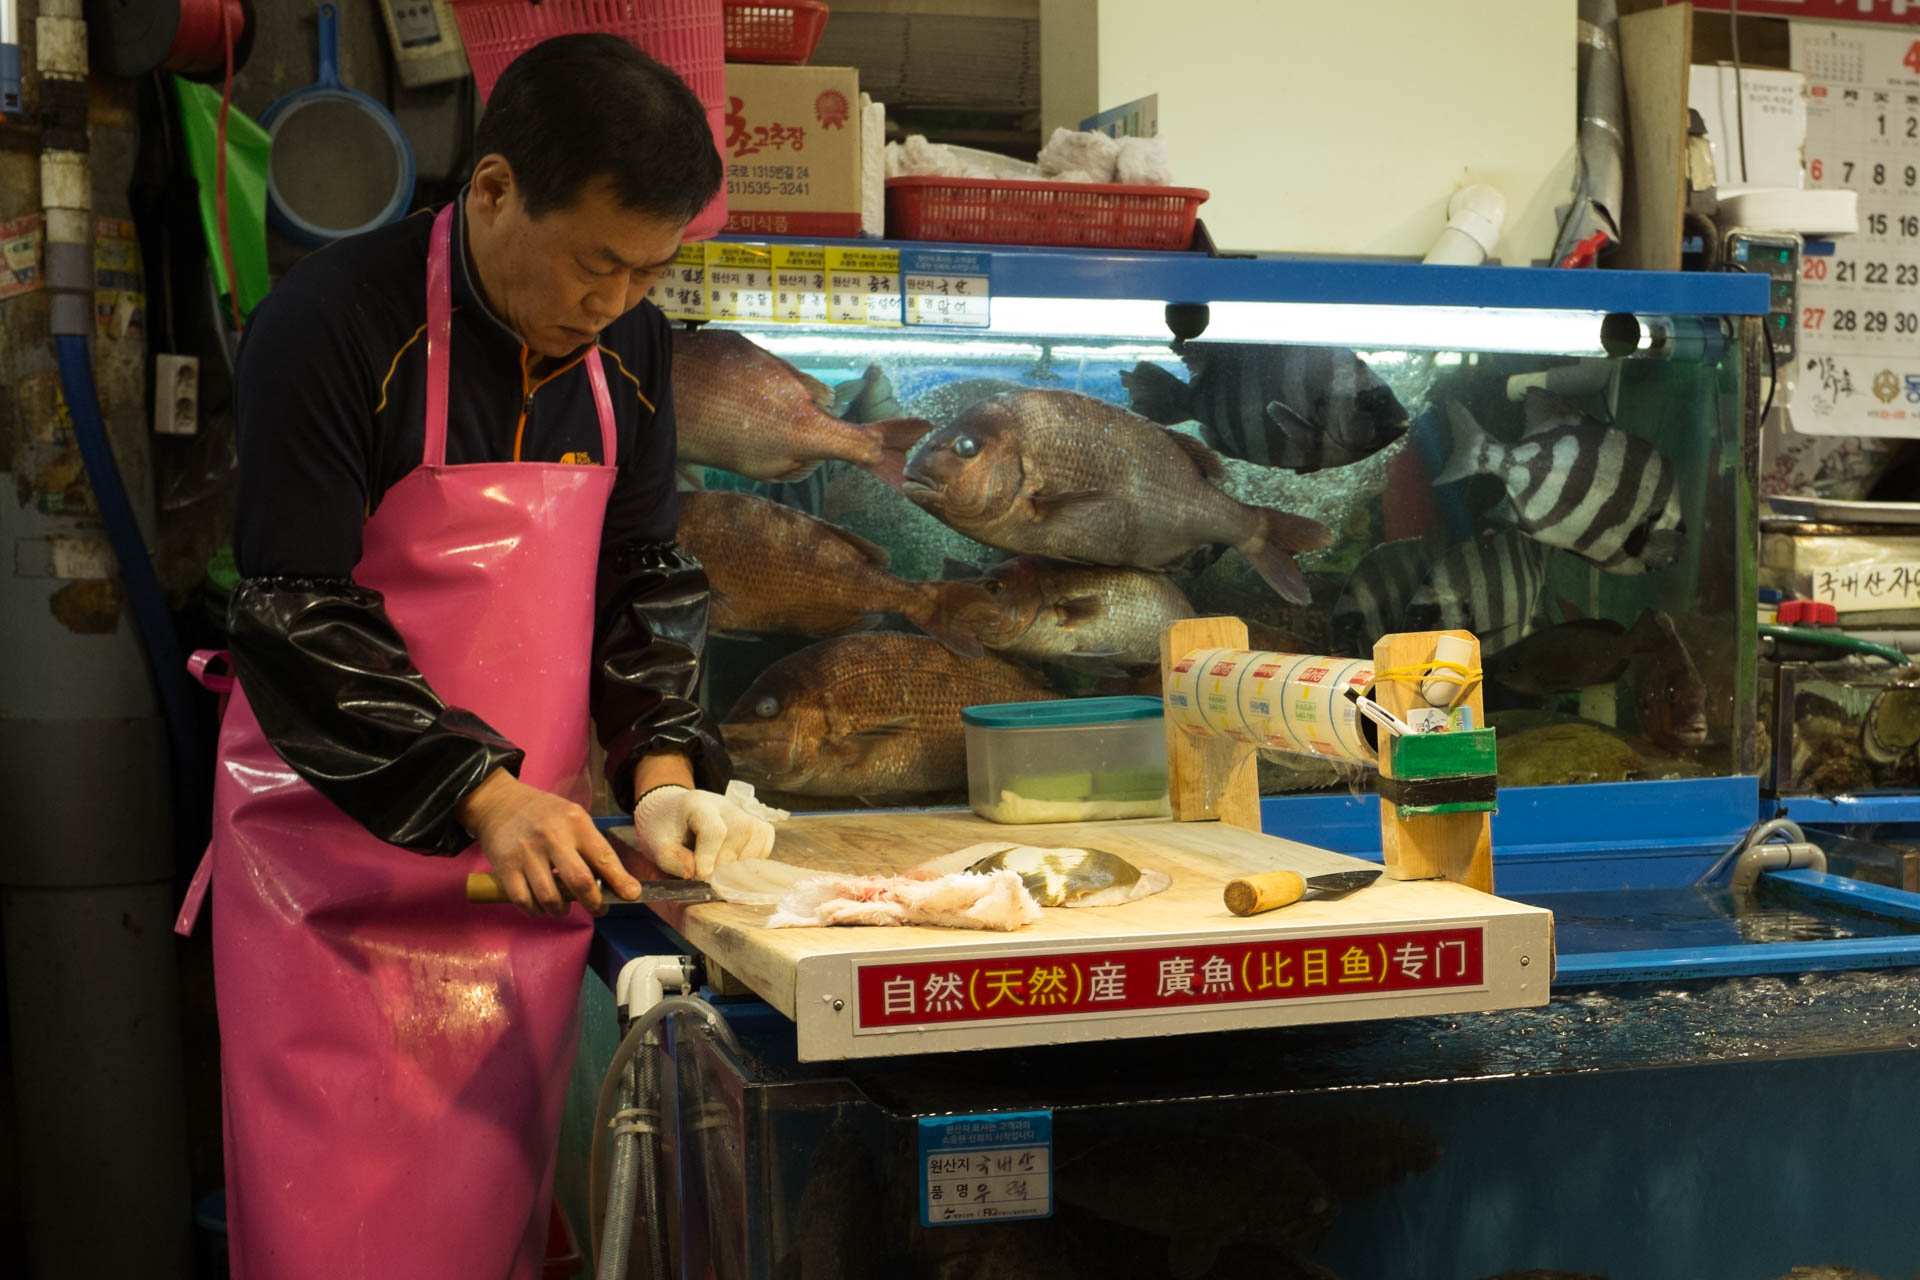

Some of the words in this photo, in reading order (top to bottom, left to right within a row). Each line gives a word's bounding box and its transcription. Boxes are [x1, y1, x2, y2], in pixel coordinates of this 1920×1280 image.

[1877, 114, 1885, 135] 1
[1906, 117, 1918, 138] 2
[797, 166, 809, 179] 24
[1811, 158, 1823, 181] 6
[1843, 162, 1855, 183] 7
[1873, 163, 1885, 185] 8
[1904, 165, 1916, 187] 9
[1868, 213, 1888, 235] 15
[1898, 215, 1919, 237] 16
[711, 272, 740, 285] 원산지
[779, 274, 807, 286] 원산지
[1802, 258, 1827, 280] 20
[1836, 261, 1856, 282] 21
[1865, 262, 1888, 284] 22
[1896, 264, 1918, 286] 23
[832, 275, 860, 288] 원산지
[907, 278, 934, 291] 원산지
[1802, 308, 1825, 330] 27
[1833, 309, 1857, 331] 28
[1864, 311, 1887, 332] 29
[1894, 312, 1918, 334] 30
[930, 1157, 969, 1174] 원산지
[930, 1184, 944, 1200] 품
[957, 1183, 968, 1198] 명
